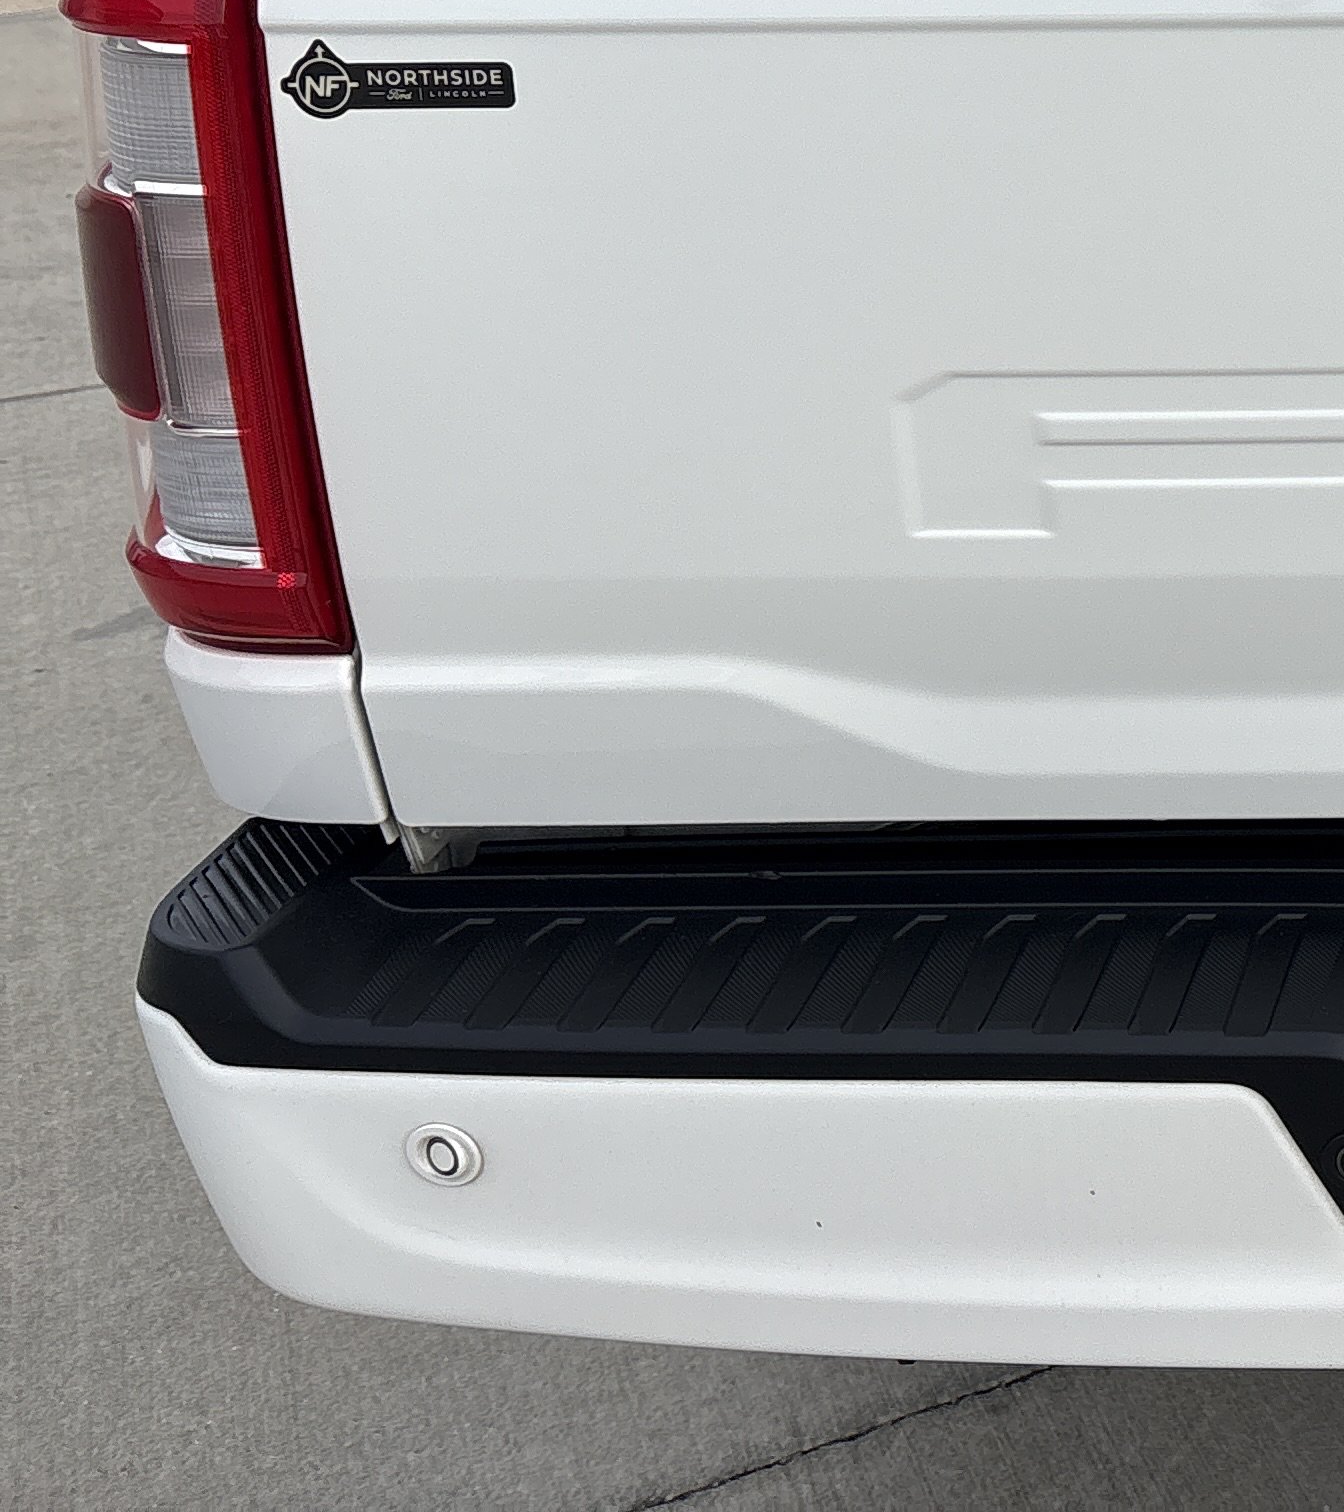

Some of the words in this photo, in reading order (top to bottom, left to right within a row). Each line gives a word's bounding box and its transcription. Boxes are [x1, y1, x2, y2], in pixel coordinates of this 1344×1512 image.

[366, 69, 504, 86] NORTHSIDE
[304, 75, 347, 104] NF
[386, 88, 413, 101] Ford
[429, 90, 487, 99] LINCOLN
